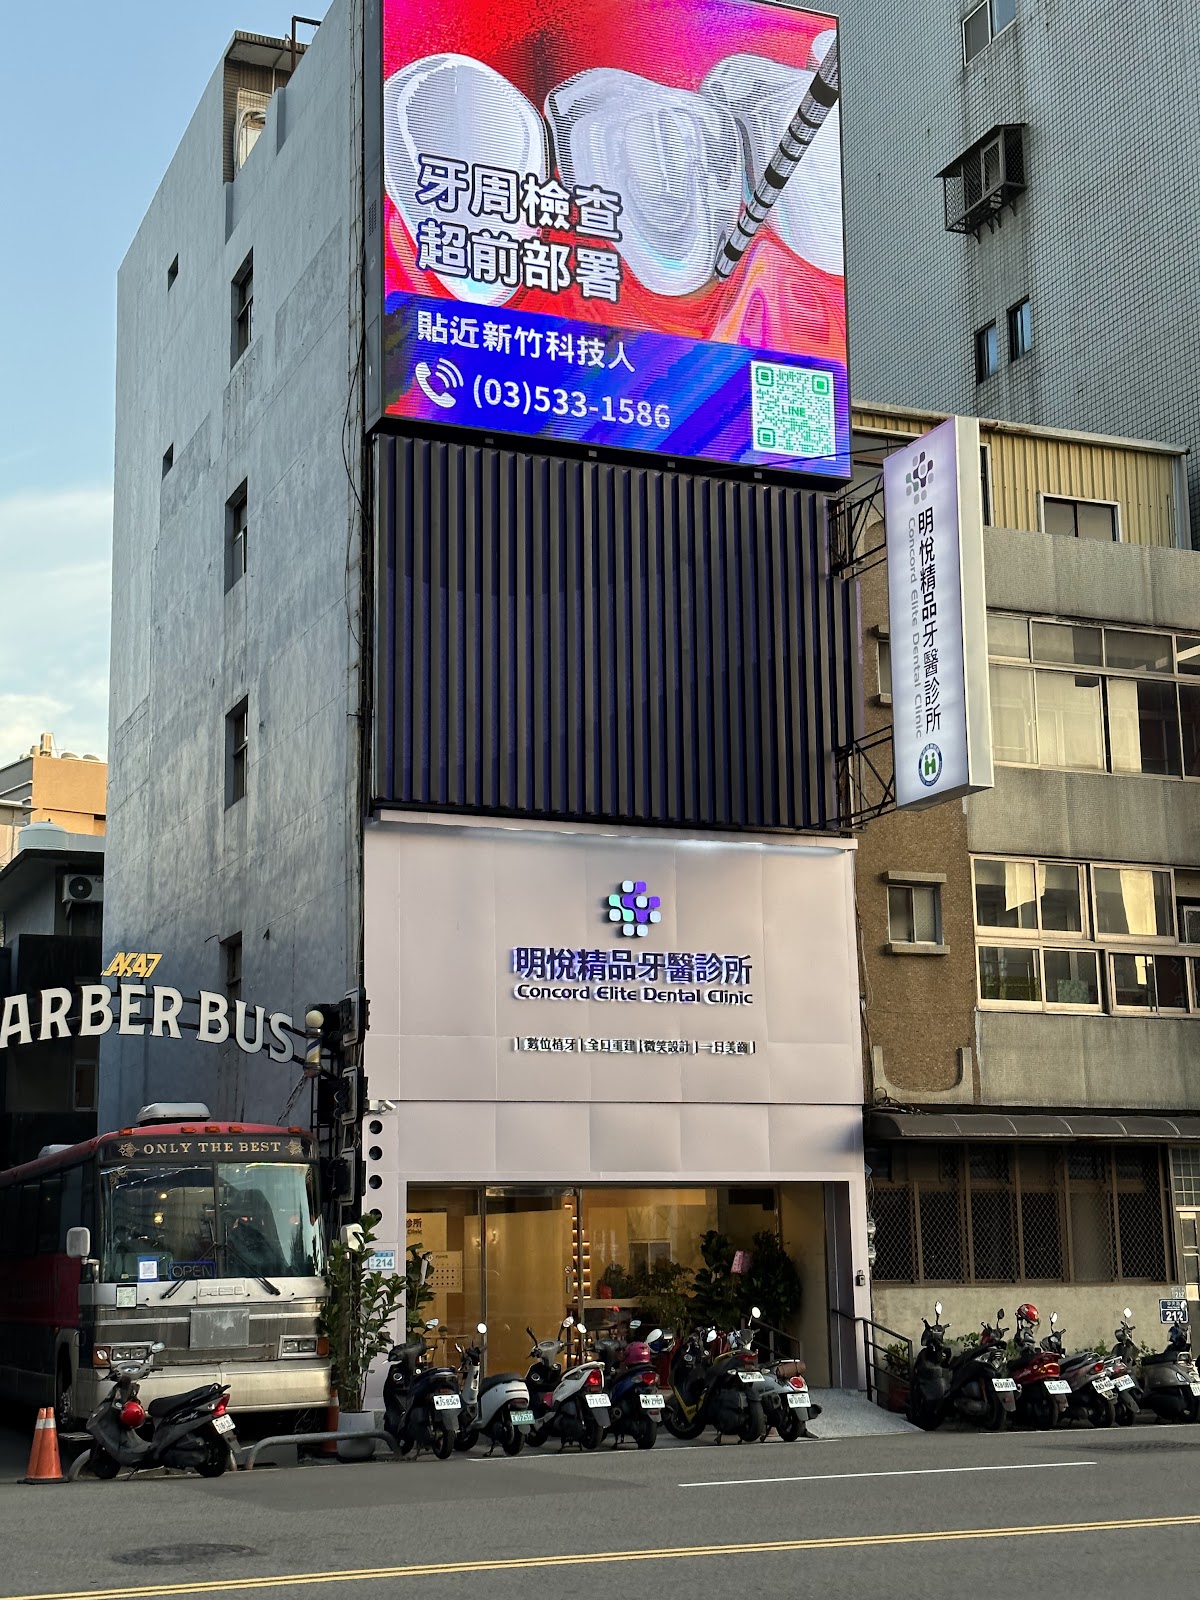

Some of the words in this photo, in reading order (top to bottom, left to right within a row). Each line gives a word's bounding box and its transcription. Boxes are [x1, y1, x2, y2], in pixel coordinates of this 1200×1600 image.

[416, 153, 623, 242] 牙周檢查
[416, 217, 623, 303] 超前部署
[417, 310, 636, 373] 貼近新竹科技人
[473, 373, 671, 430] (03)533-1586
[781, 404, 806, 418] LINE
[908, 516, 918, 584] Concord
[911, 588, 919, 627] Elite
[918, 505, 941, 735] 明悅精品牙醫診所
[912, 631, 922, 688] Dental
[914, 693, 923, 739] Clinic
[515, 947, 753, 986] 明悅精品牙醫診所
[516, 984, 590, 1000] Concord
[596, 985, 637, 1001] Elite
[643, 987, 701, 1003] Dental
[707, 989, 753, 1005] Clinic
[197, 989, 295, 1063] BUS
[143, 1142, 192, 1154] ONLY
[198, 1142, 234, 1153] THE
[239, 1141, 281, 1152] BEST
[172, 1264, 213, 1278] OPEN
[375, 1258, 393, 1268] 214
[1165, 1310, 1184, 1321] 212
